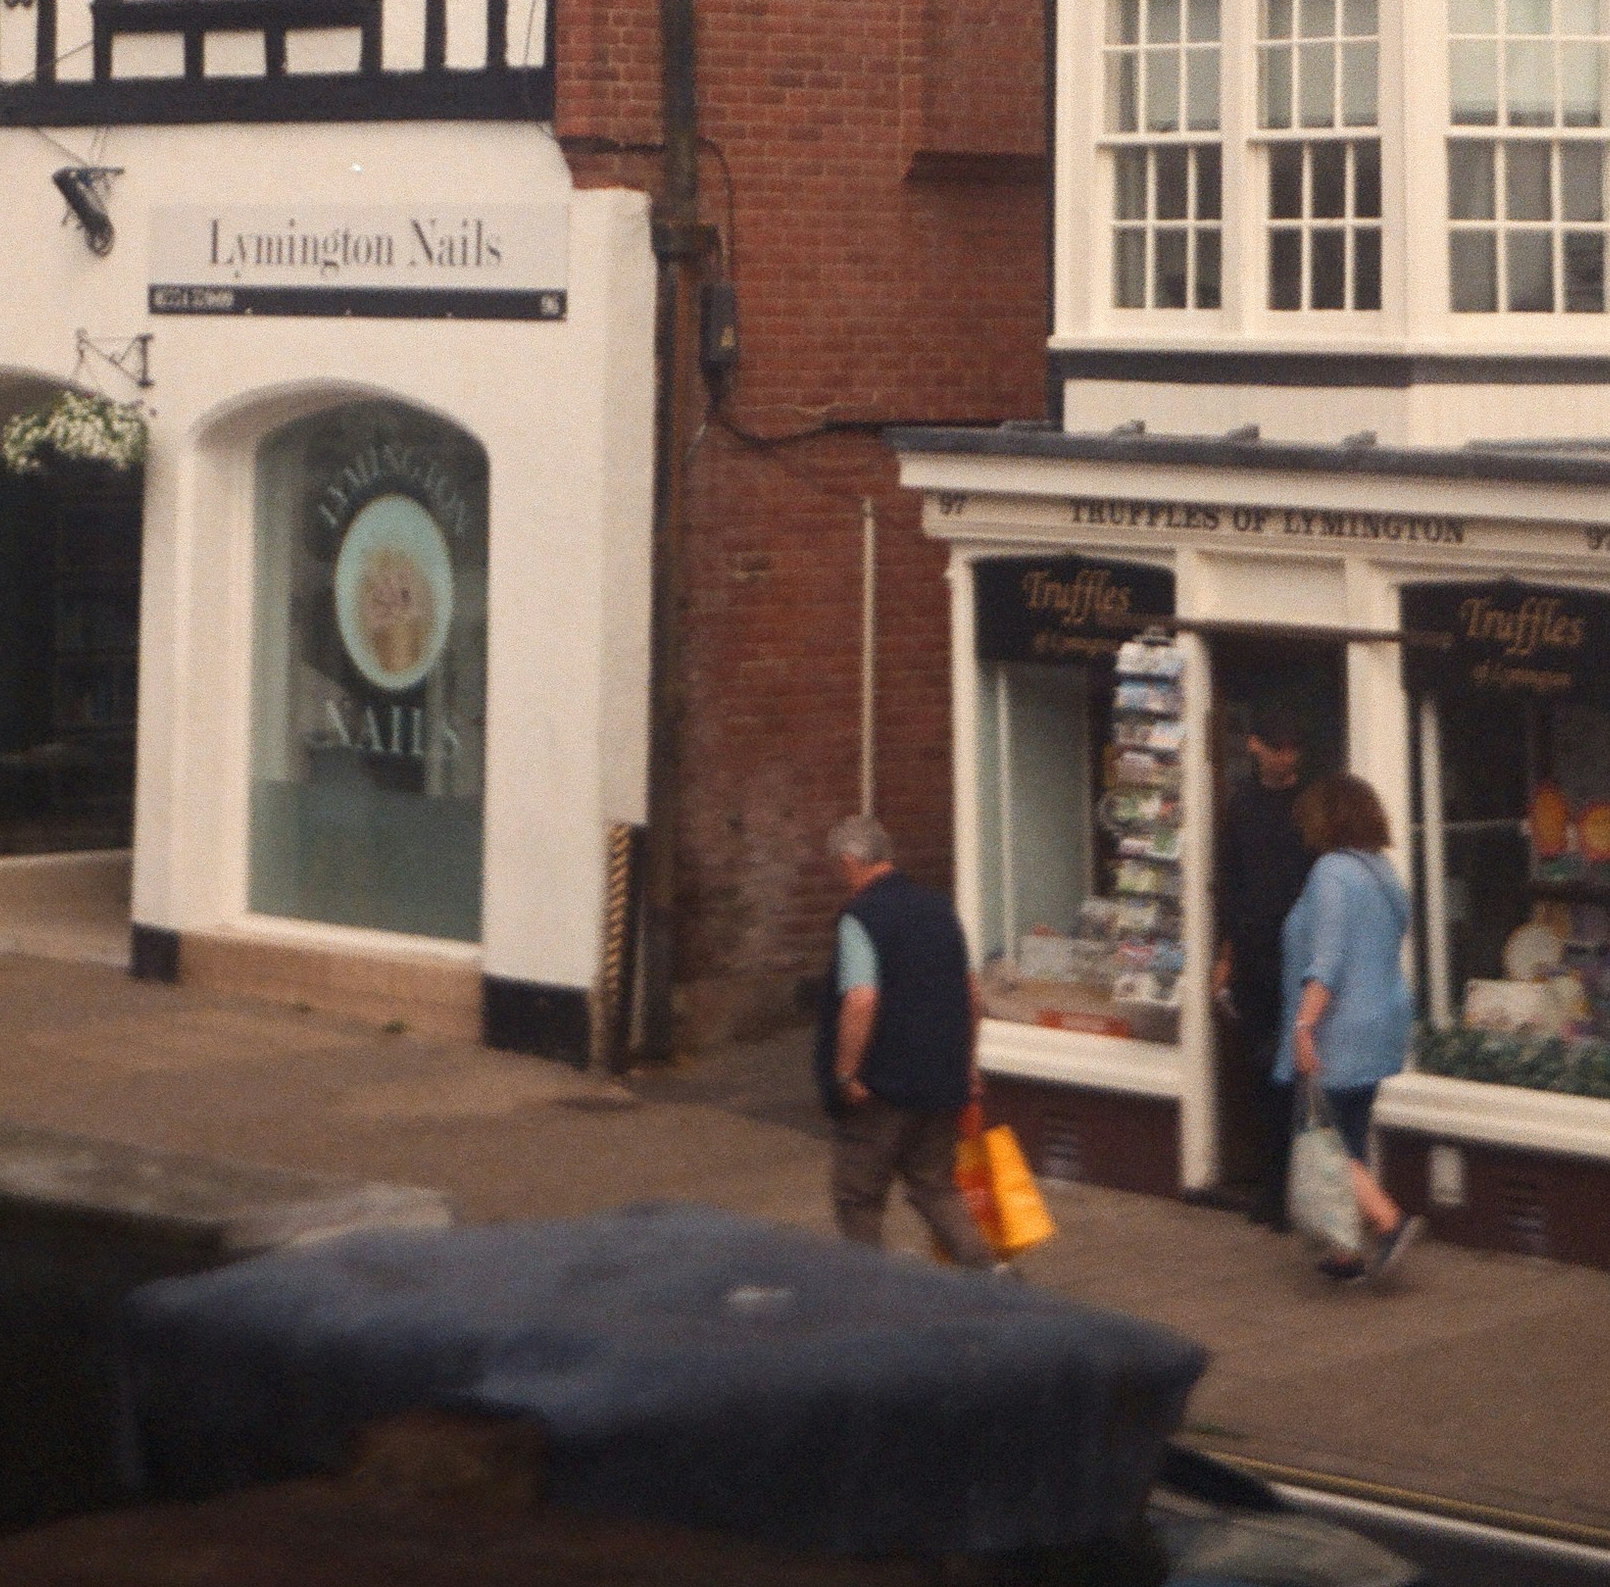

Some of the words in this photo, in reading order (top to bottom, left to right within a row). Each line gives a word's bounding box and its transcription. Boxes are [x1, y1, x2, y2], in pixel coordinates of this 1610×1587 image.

[208, 217, 394, 279] Lymington
[406, 216, 504, 269] Nails
[938, 493, 969, 517] 97
[1071, 498, 1219, 533] TRUFFLES
[1231, 504, 1272, 534] OF
[1281, 508, 1467, 545] LYMINGTON
[1021, 569, 1132, 626] Truffles
[1460, 596, 1588, 656] Truffles
[324, 697, 464, 767] NAILS
